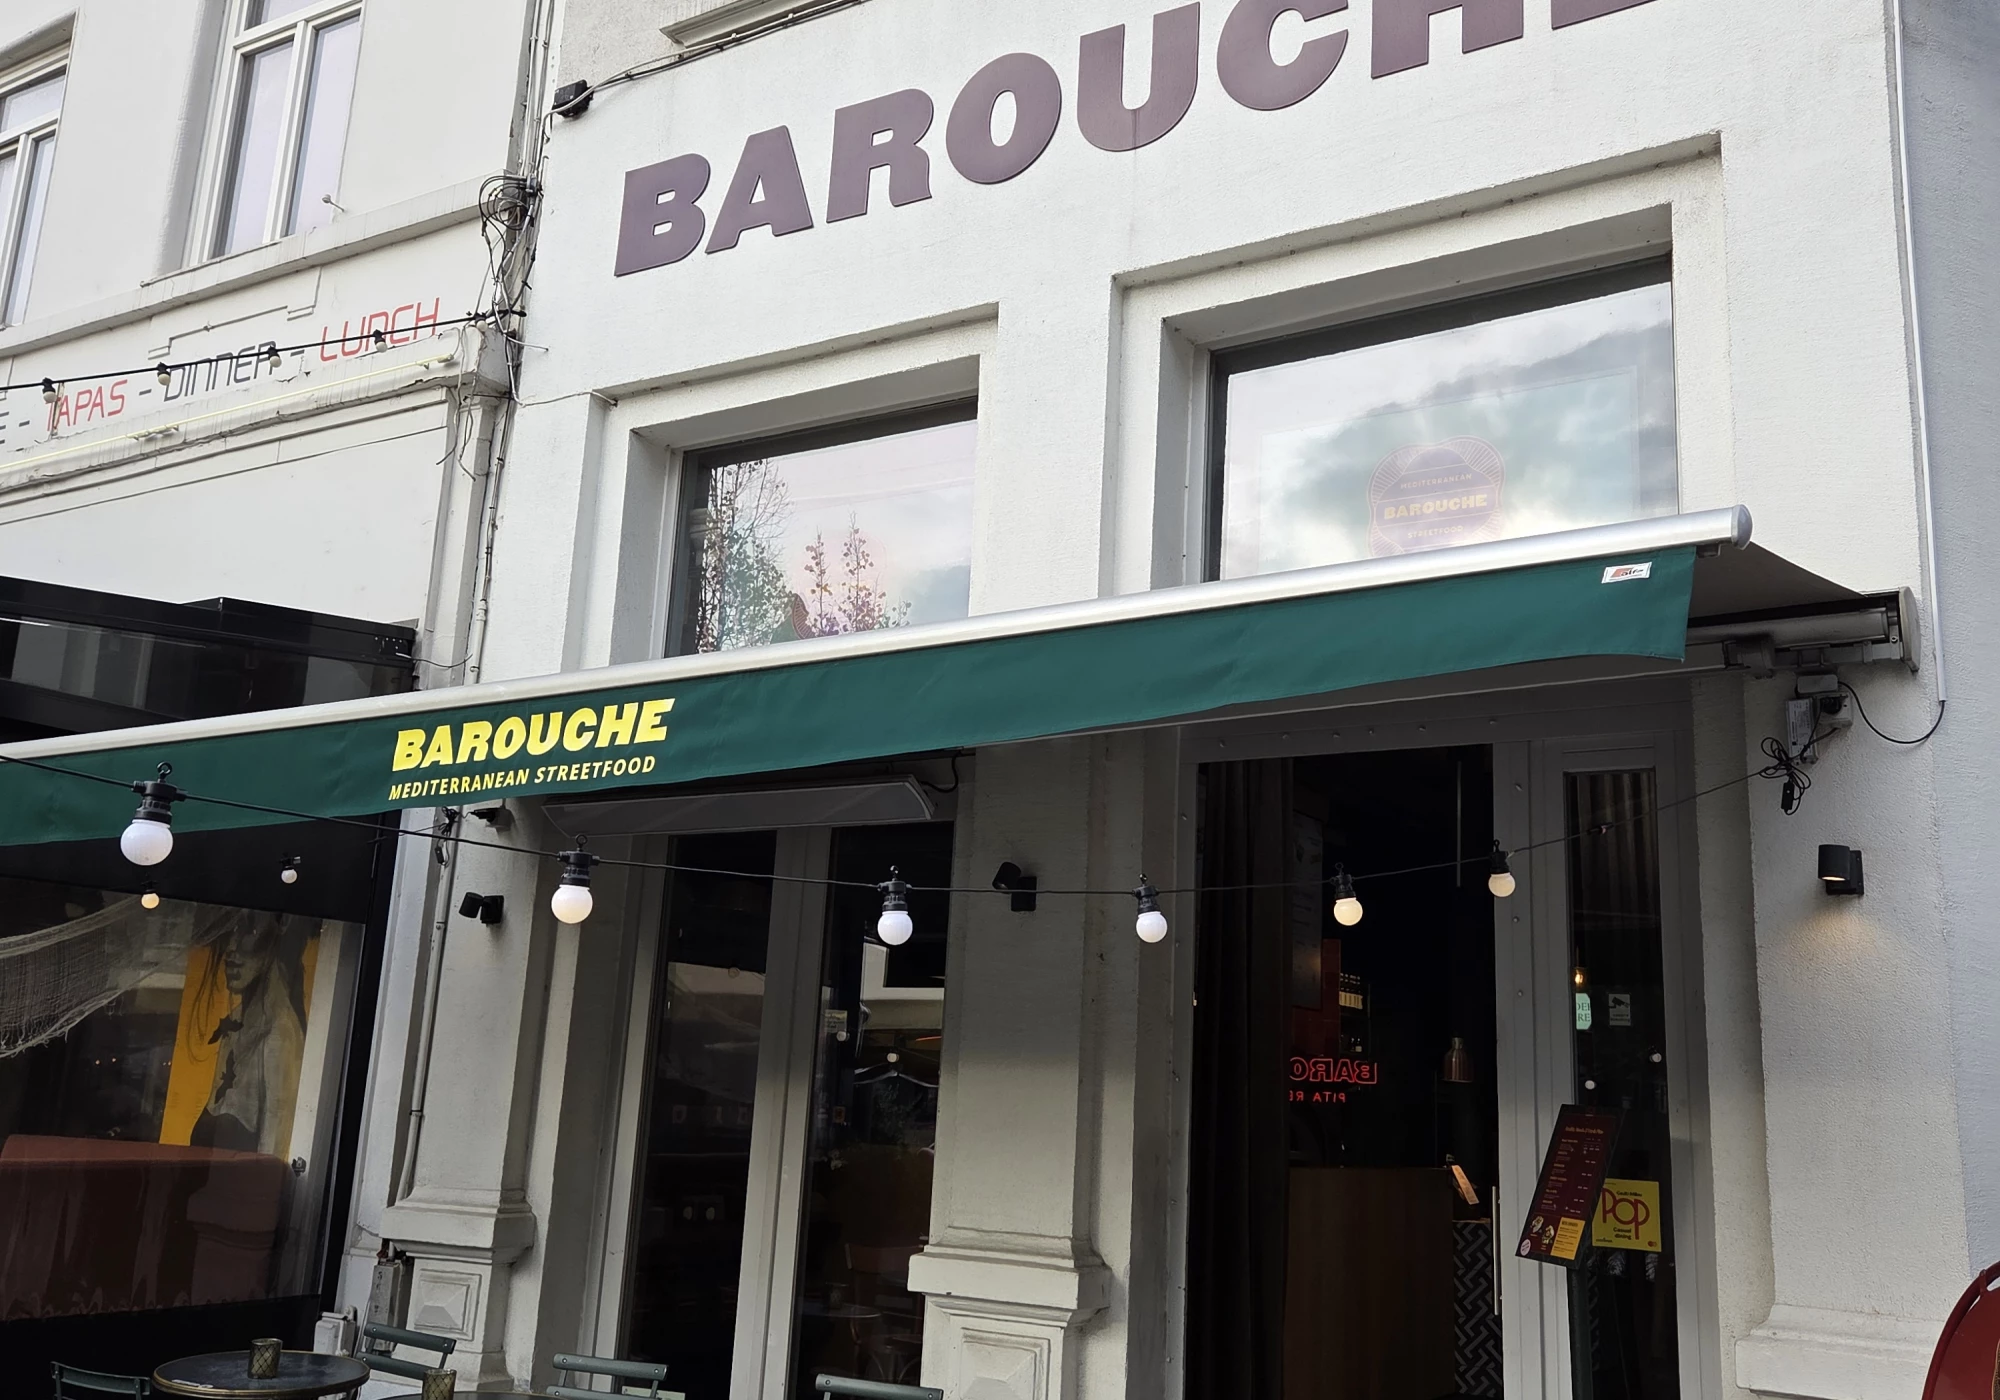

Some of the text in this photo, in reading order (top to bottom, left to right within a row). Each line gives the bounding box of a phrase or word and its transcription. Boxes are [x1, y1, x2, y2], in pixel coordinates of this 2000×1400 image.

[614, 0, 1655, 276] BAROUCH
[46, 379, 128, 431] TAPAS
[320, 297, 440, 362] LUNCH
[1400, 473, 1472, 489] MEDITERRANEAN
[1384, 494, 1488, 520] BAROUCHE
[1408, 525, 1464, 539] STREETFOOD
[392, 698, 676, 772] BAROUCHE
[389, 755, 656, 801] MEDITERRANEAN STREETFOOD
